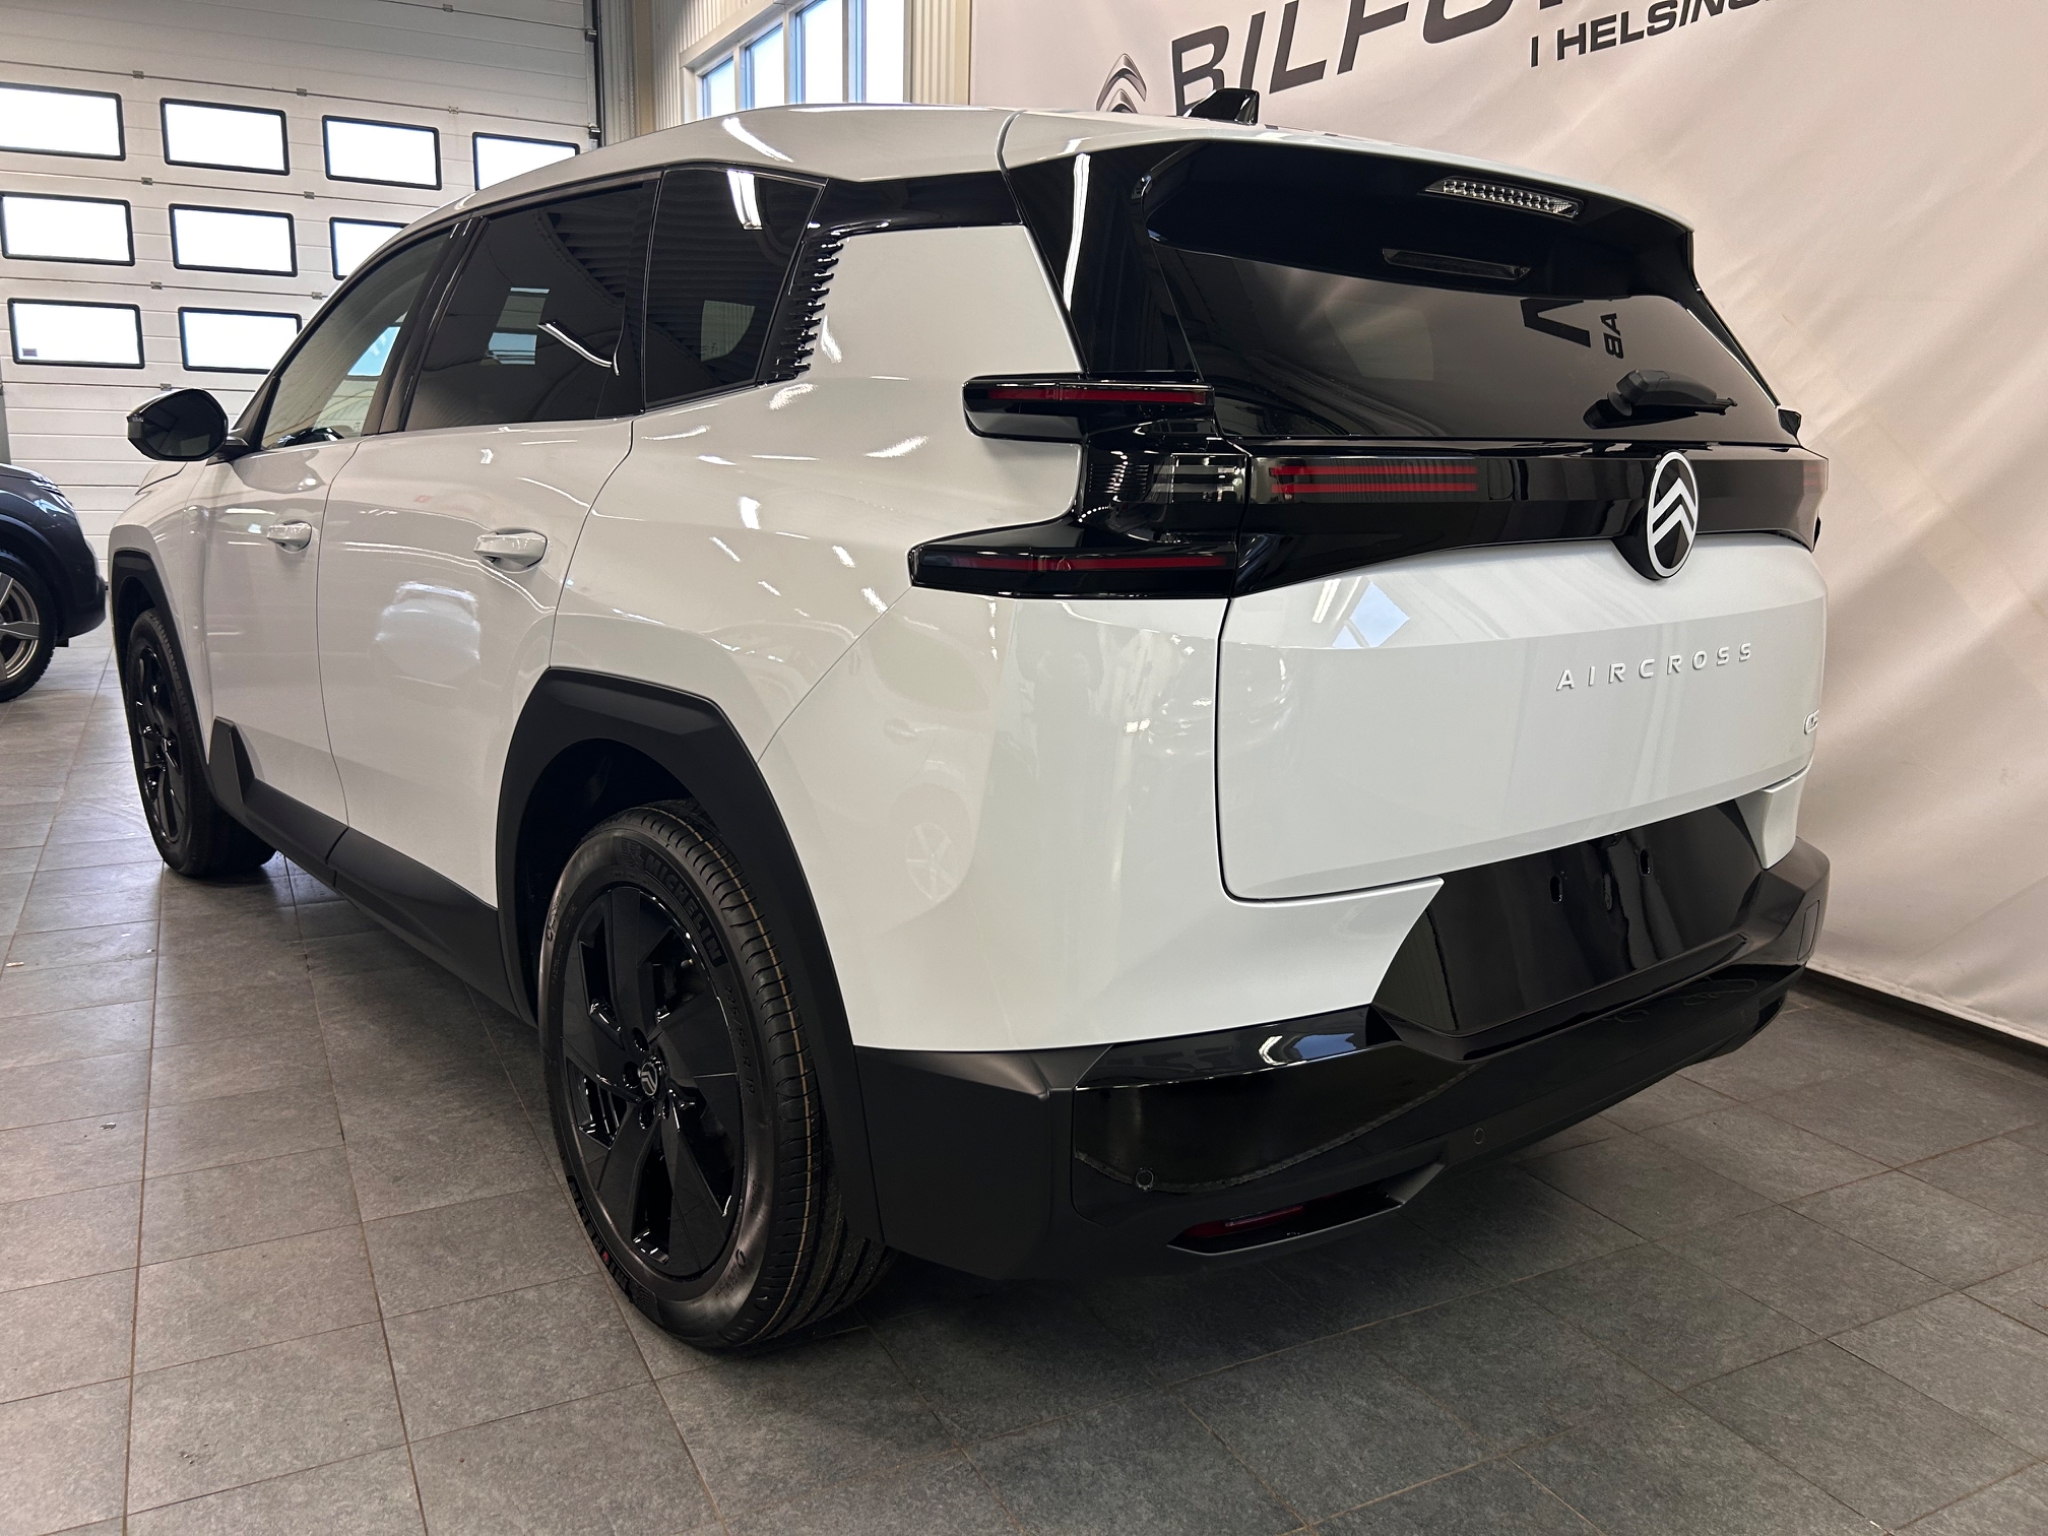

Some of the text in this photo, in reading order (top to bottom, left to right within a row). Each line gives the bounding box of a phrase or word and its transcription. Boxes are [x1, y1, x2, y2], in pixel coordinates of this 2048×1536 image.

[1171, 0, 1563, 116] BILF
[1530, 35, 1539, 68] I
[1556, 642, 1751, 691] AIRCROSS
[645, 853, 722, 960] MICHELIN
